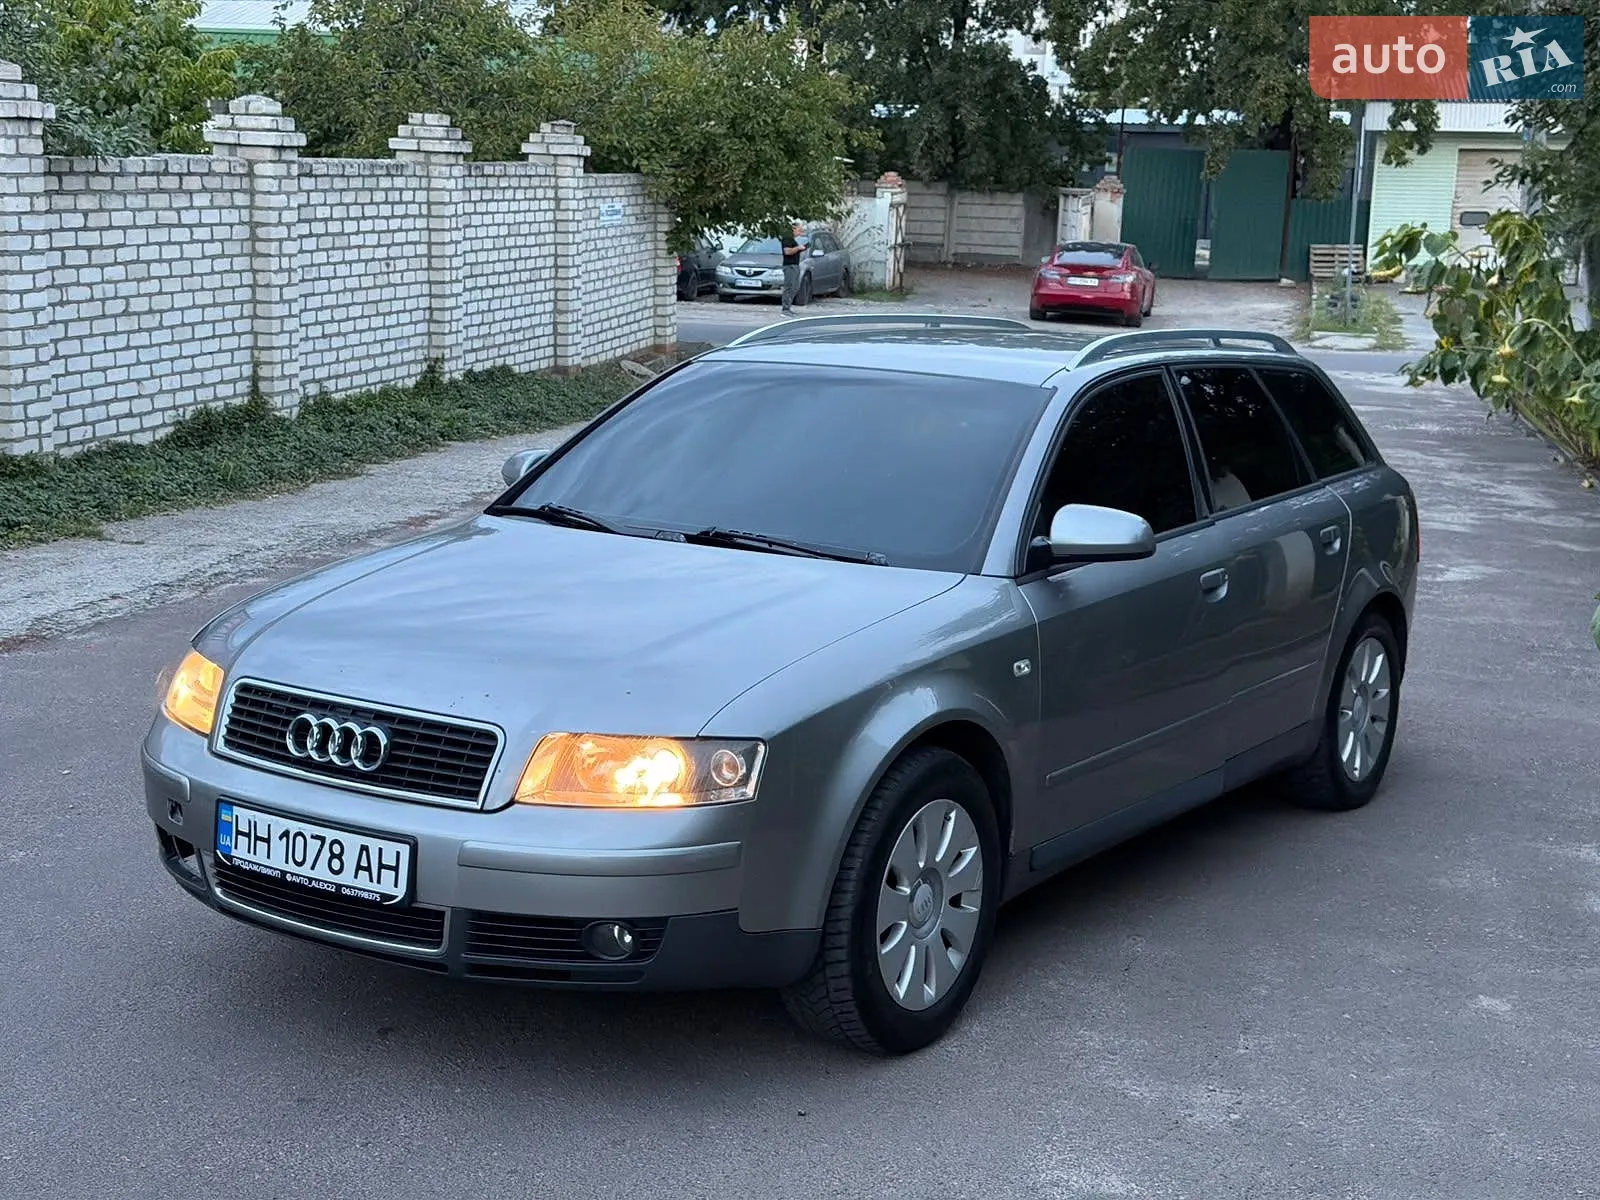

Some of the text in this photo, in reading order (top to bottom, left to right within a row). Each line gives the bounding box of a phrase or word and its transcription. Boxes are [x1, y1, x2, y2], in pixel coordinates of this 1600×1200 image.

[219, 834, 232, 847] UA
[233, 814, 401, 889] HH 1078 AH
